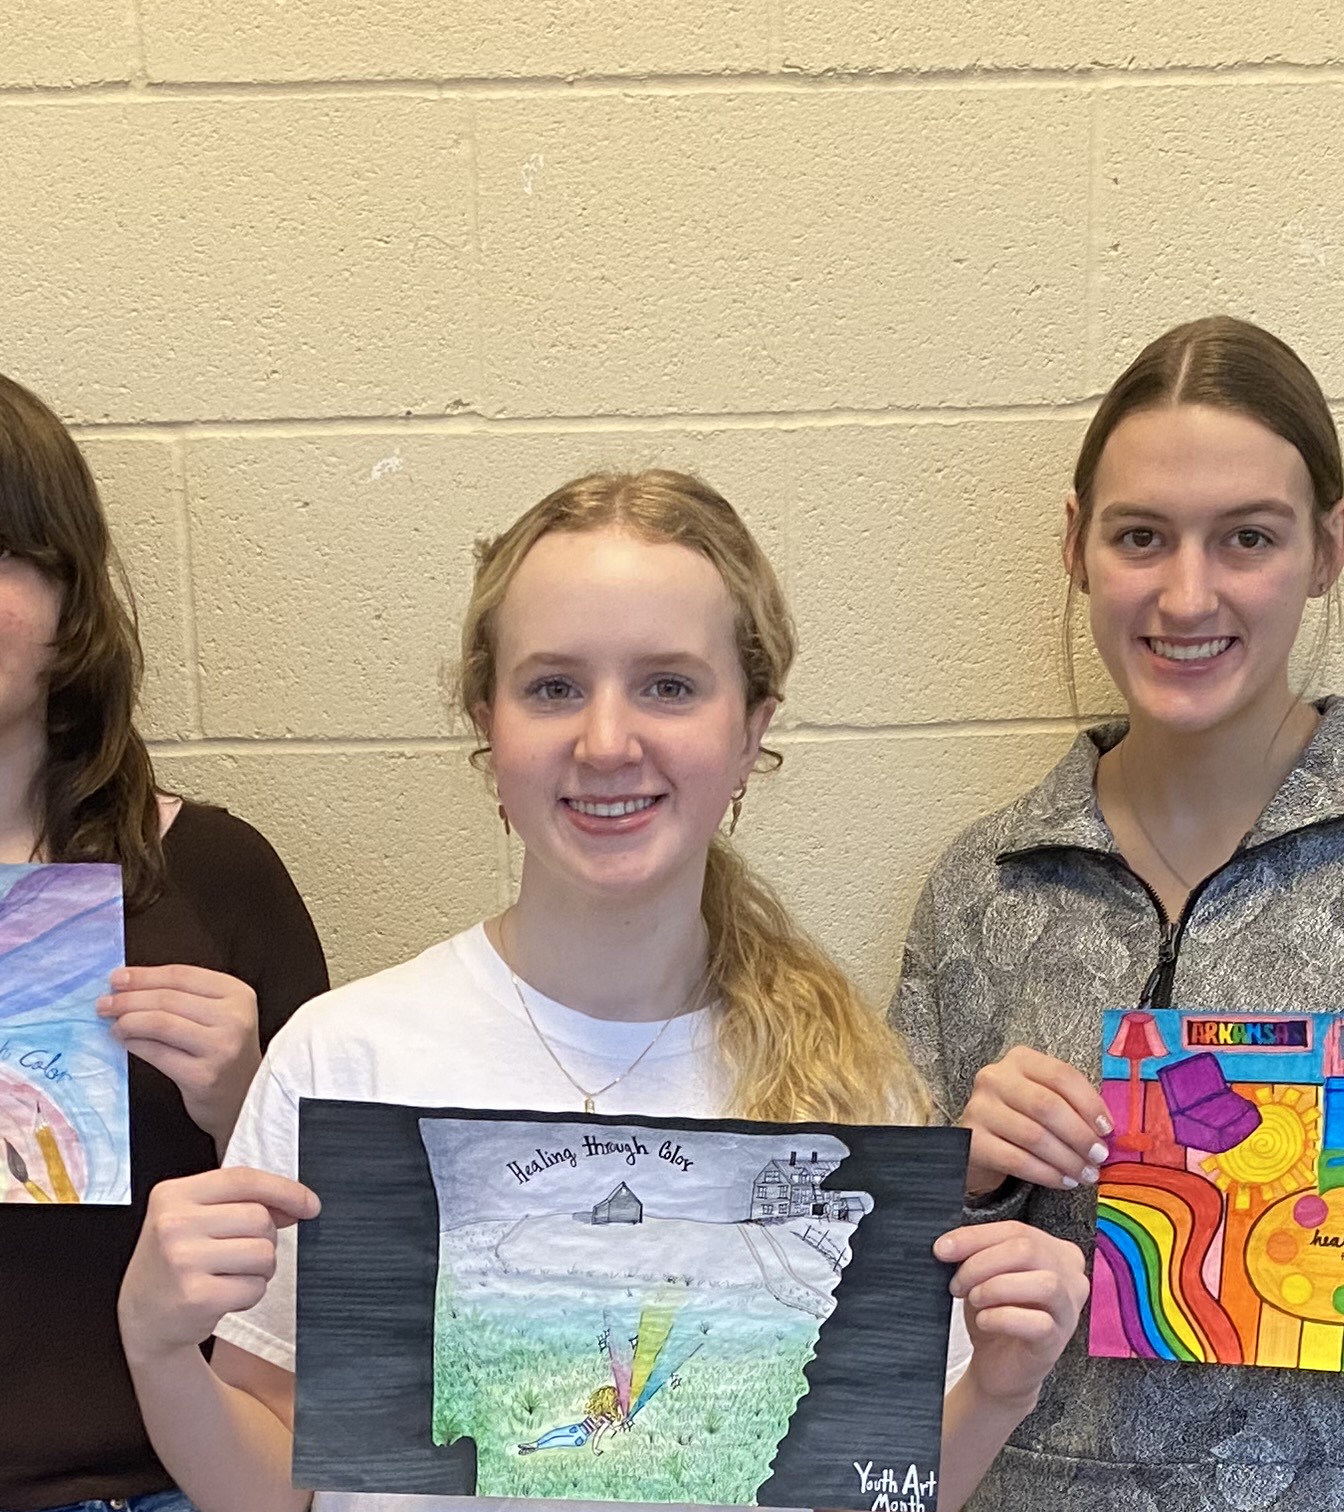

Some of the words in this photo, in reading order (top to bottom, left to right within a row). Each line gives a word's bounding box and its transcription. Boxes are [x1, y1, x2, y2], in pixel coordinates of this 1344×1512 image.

[506, 1147, 578, 1185] Healing
[658, 1140, 694, 1172] Color
[853, 1461, 898, 1494] Youth
[901, 1463, 937, 1498] Art
[871, 1493, 925, 1512] Month
